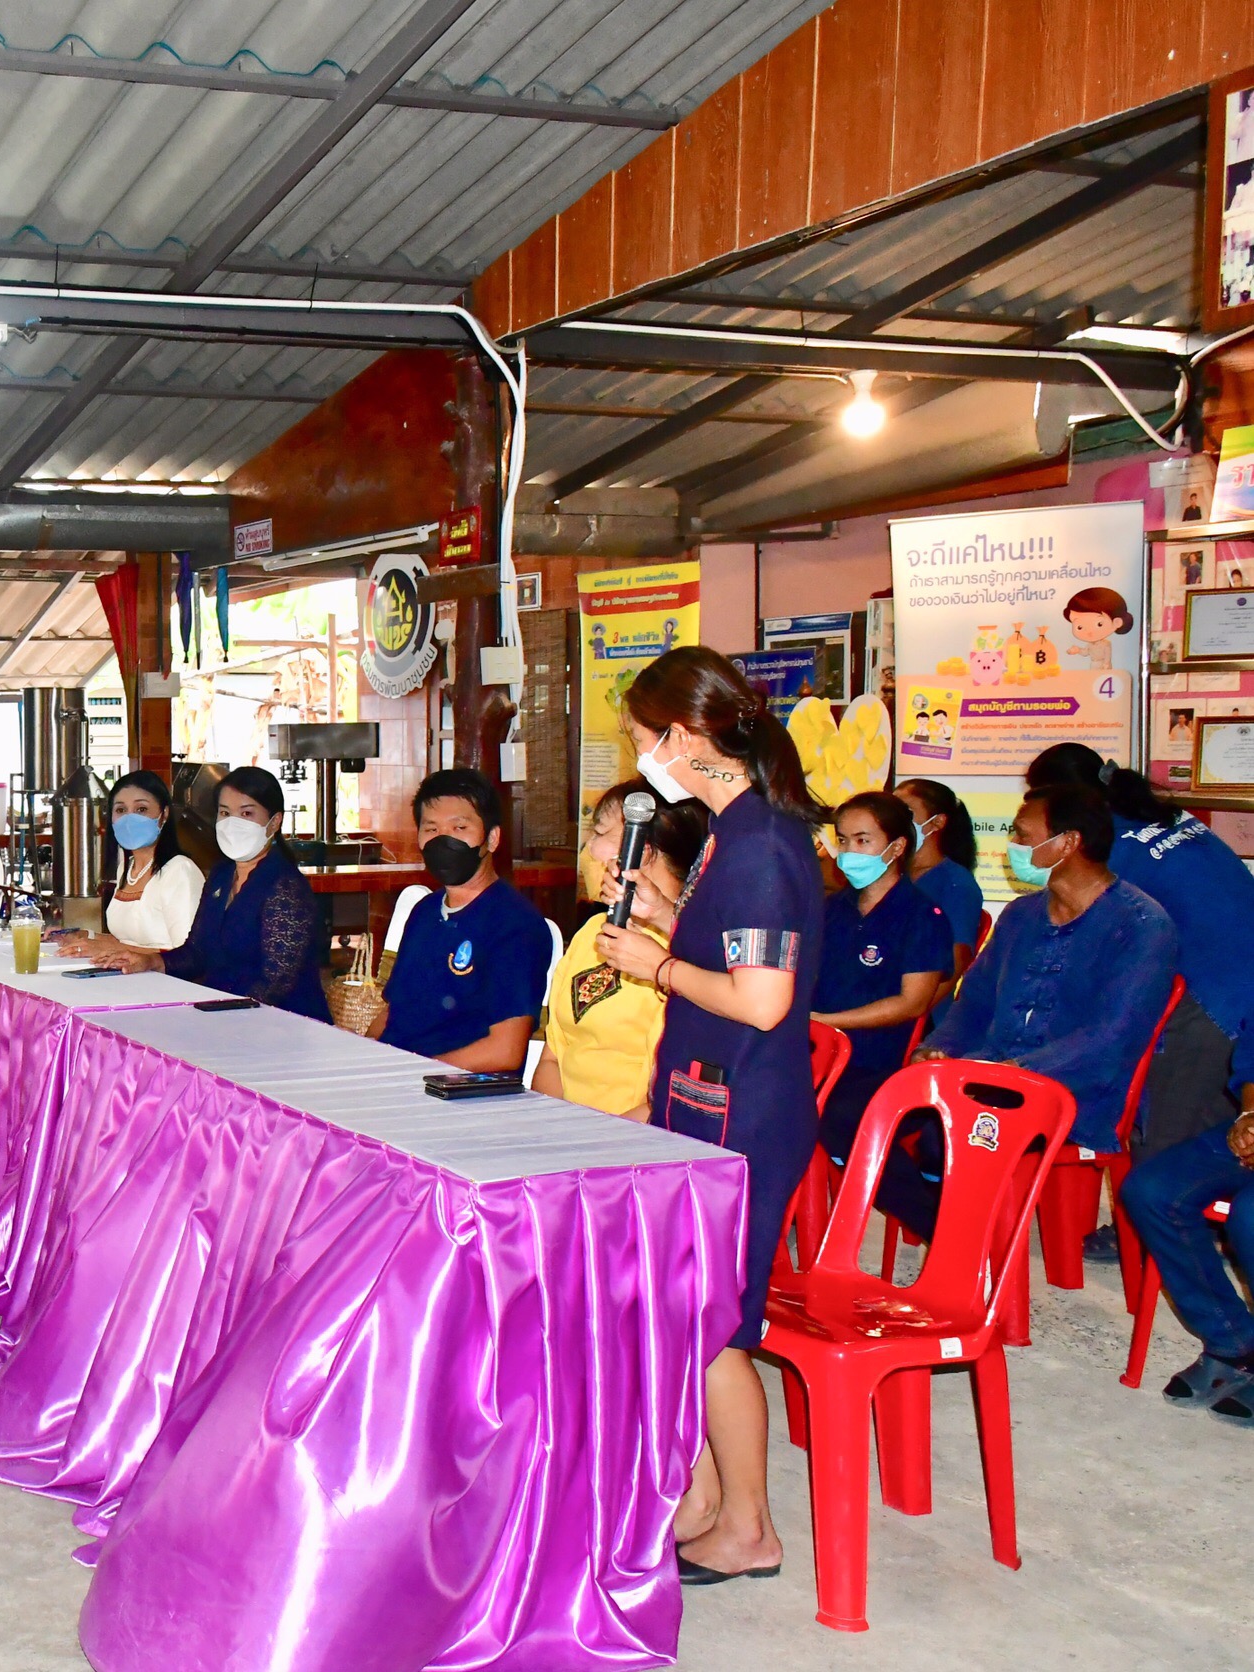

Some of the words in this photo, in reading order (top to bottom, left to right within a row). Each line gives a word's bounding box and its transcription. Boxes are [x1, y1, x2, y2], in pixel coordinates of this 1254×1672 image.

[906, 534, 1054, 567] จะดีแค่ไหน!!!
[909, 562, 1112, 588] ถ้าเราสามารถรู้ทุกความเคลื่อนไหว
[909, 585, 1056, 607] ของวงเงินว่าไปอยู่ที่ไหน?
[1099, 677, 1115, 699] 4
[968, 699, 1071, 712] สมุดบัญชีตามรอยพ่อ
[1000, 823, 1017, 834] Ap
